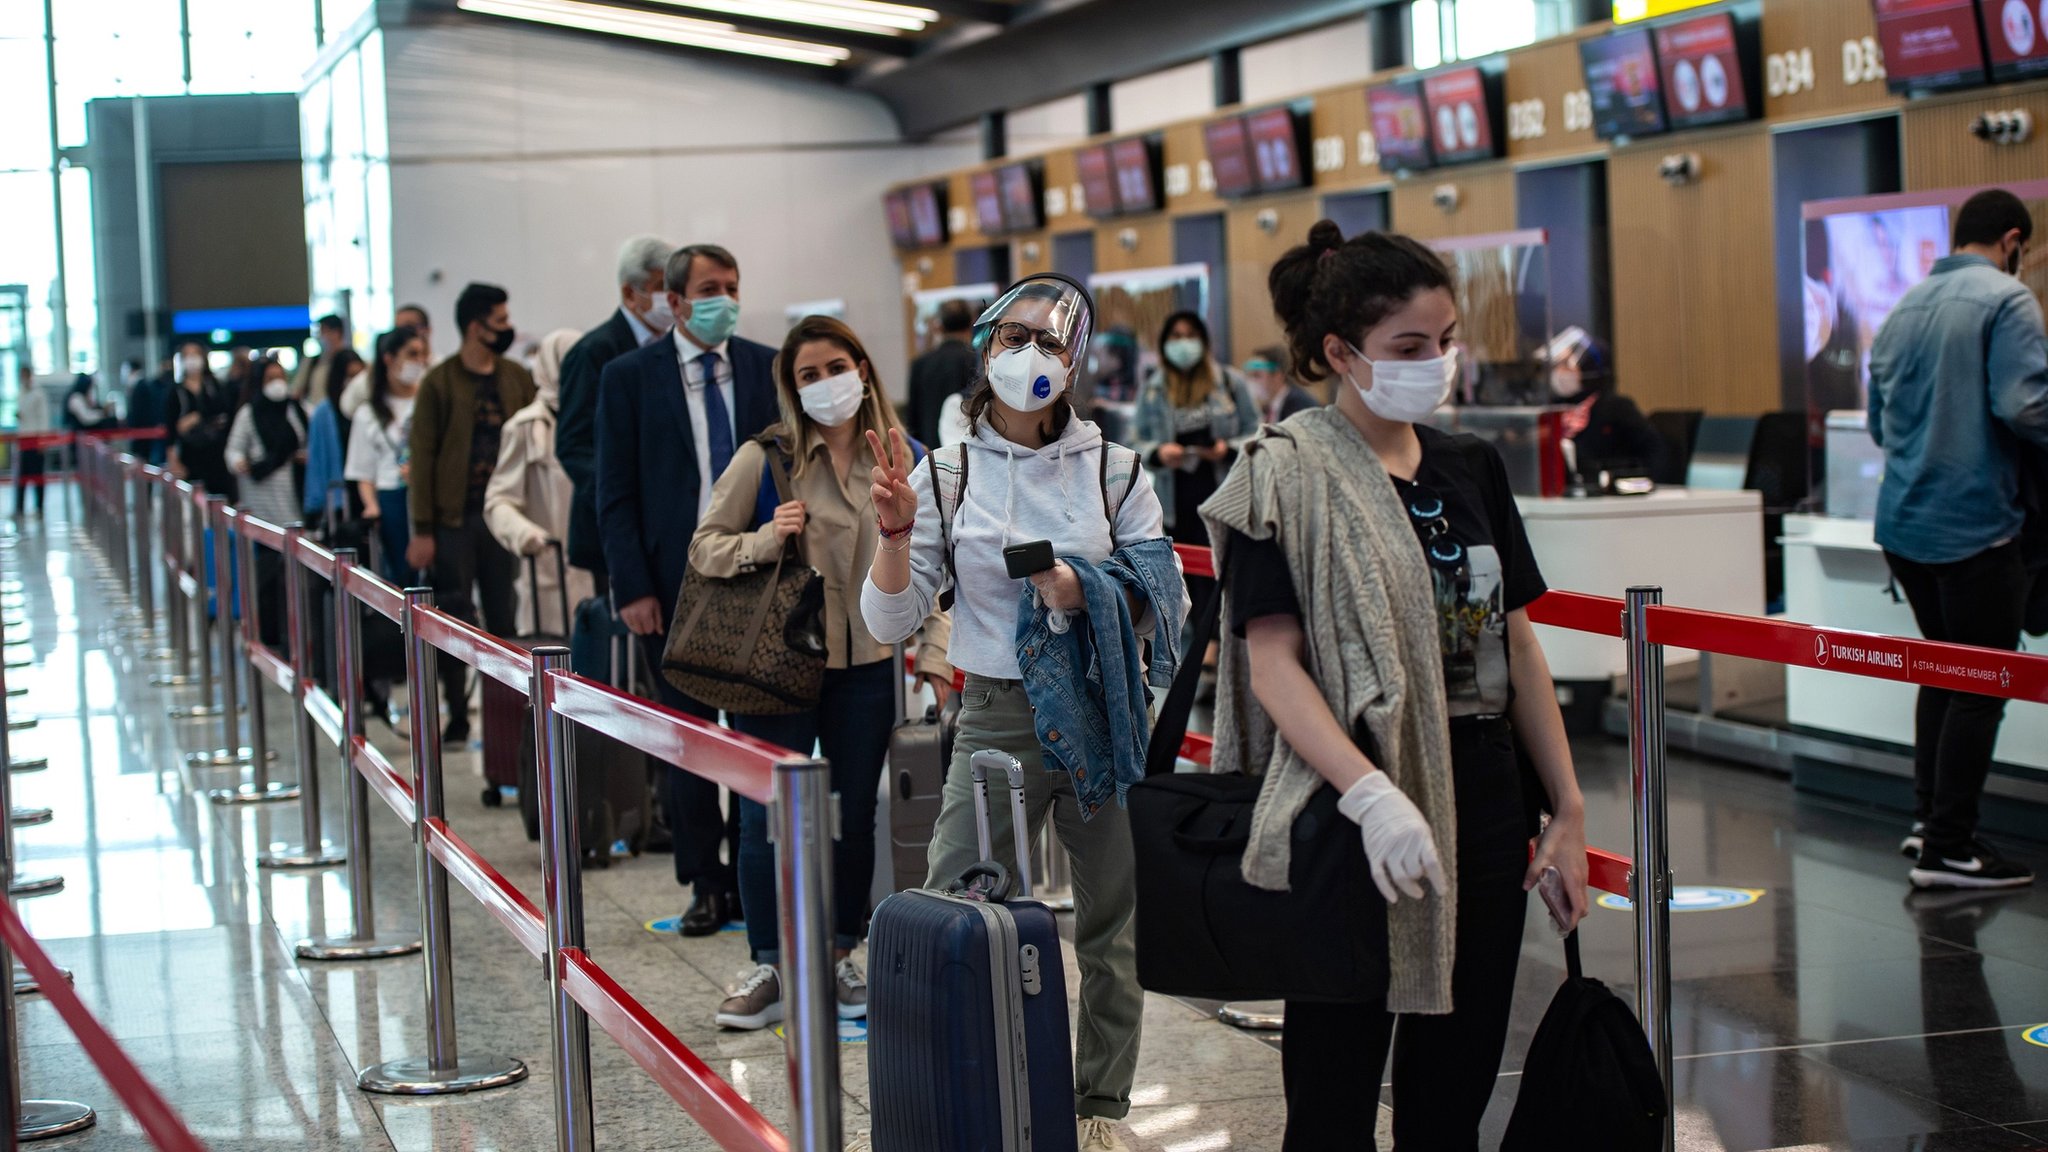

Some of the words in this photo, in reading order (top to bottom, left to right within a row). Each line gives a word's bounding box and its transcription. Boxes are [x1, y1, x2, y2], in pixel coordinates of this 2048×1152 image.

[1766, 48, 1814, 96] D34
[1831, 644, 1865, 662] TURKISH
[1867, 650, 1903, 668] AIRLINES
[1918, 661, 1934, 671] STAR
[1936, 664, 1966, 677] ALLIANCE
[1967, 668, 1997, 681] MEMBER
